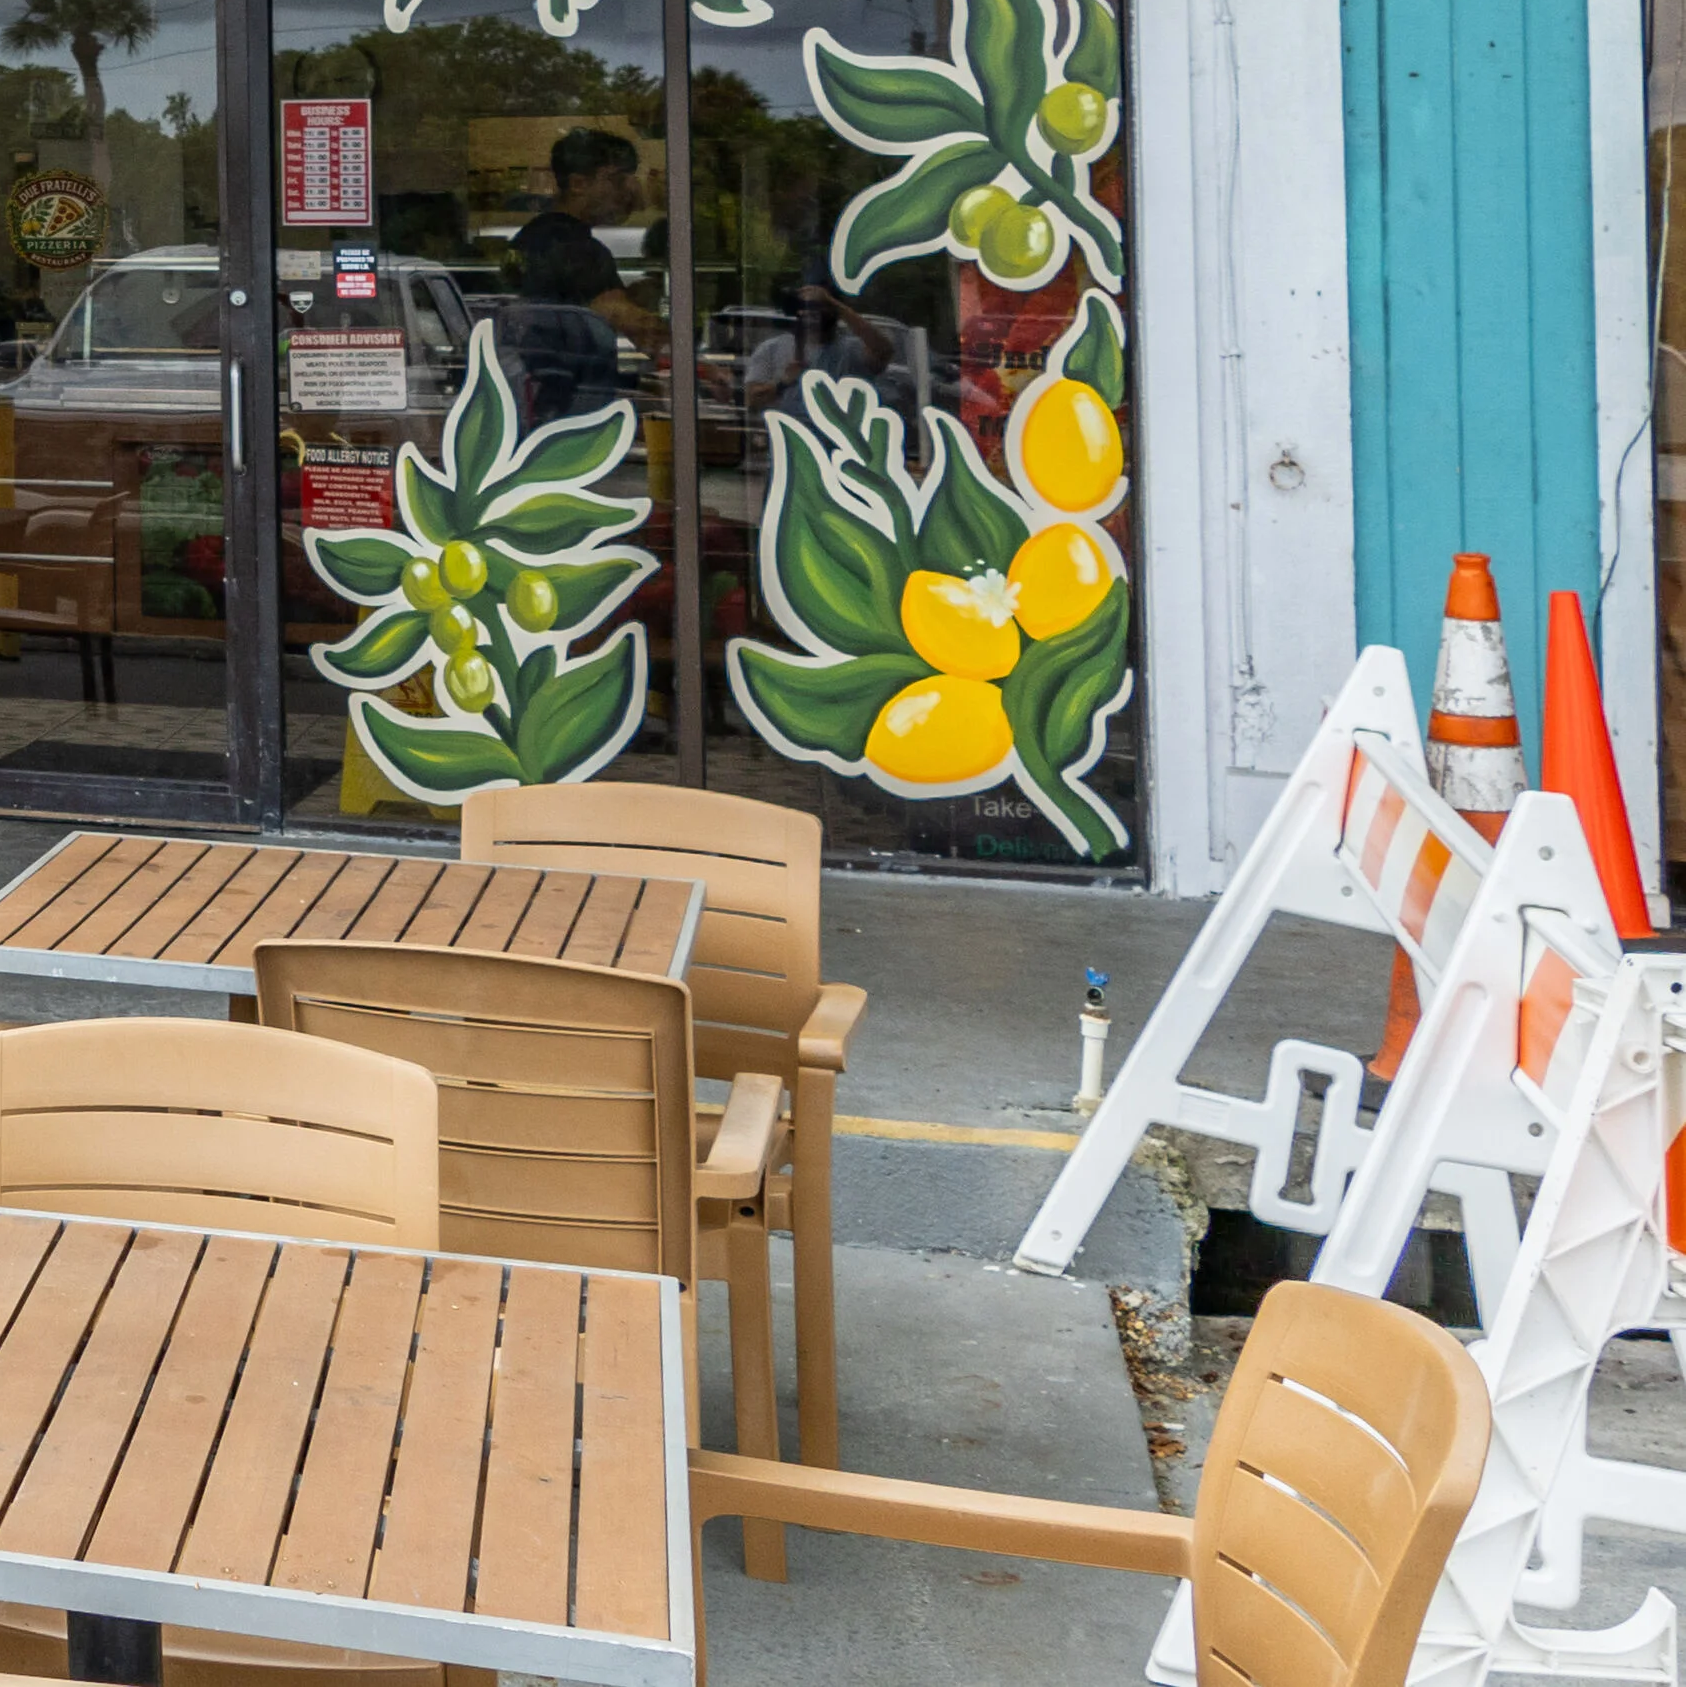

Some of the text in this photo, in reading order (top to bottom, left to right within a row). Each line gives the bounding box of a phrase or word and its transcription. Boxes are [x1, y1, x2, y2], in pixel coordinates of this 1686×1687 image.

[301, 105, 350, 116] BUSINESS
[19, 179, 97, 203] DUE FRATELLI'S
[27, 240, 87, 250] PIZZERIA
[30, 253, 87, 266] RESTAURANT
[291, 334, 401, 345] CONSUMER ADVISORY
[306, 449, 389, 465] FOOD ALLERGY NOTICE
